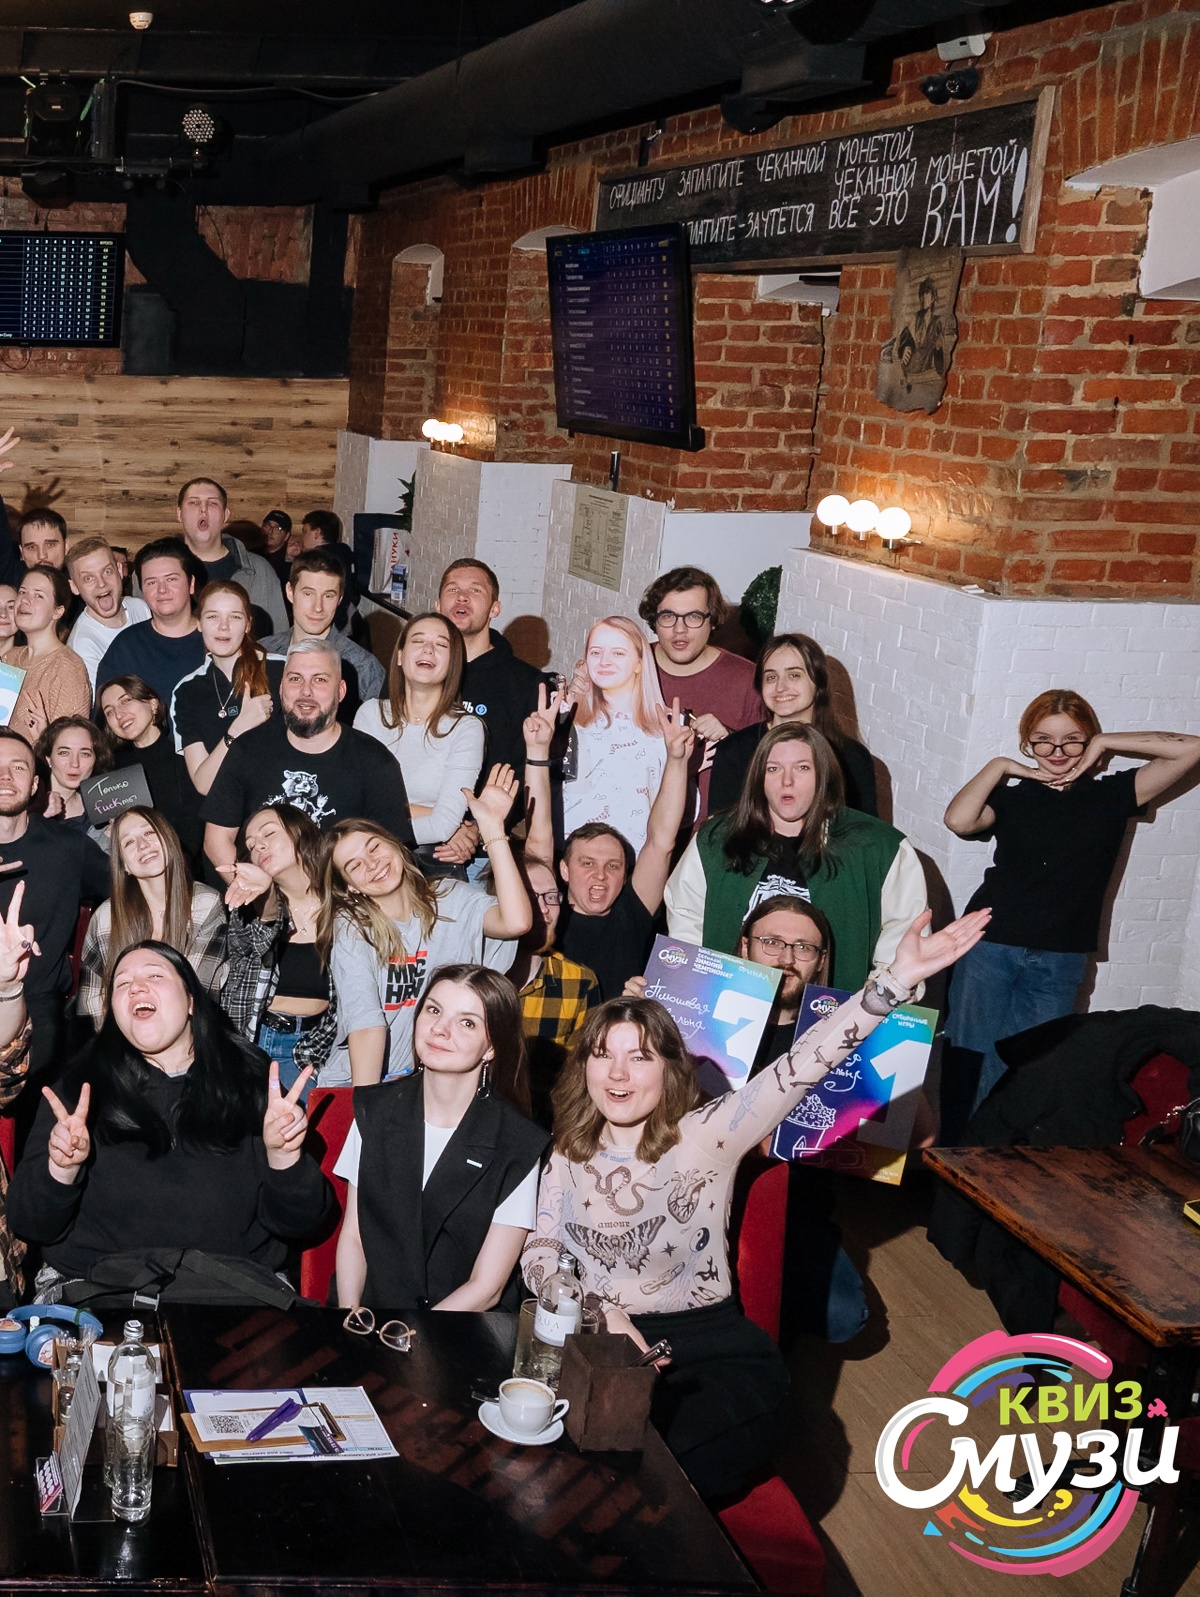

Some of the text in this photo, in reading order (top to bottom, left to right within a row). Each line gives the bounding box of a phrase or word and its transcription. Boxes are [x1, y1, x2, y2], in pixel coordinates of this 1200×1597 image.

[609, 125, 914, 210] ОФИЦИАНТУ ЗАПЛАТИТЕ ЧЕКАННОЙ МОНЕТОЙ
[834, 138, 1018, 200] ЧЕКАННОЙ МОНЕТОЙ
[828, 192, 862, 229] ВСЁ
[869, 188, 909, 226] ЭТО
[920, 146, 1028, 248] ВАМ!
[658, 949, 689, 965] Смузи
[693, 962, 734, 979] ЧЕМПИОНАТ
[695, 957, 724, 970] ЗИМНИЙ
[644, 977, 711, 1014] Плюшевая
[857, 1039, 932, 1150] 1
